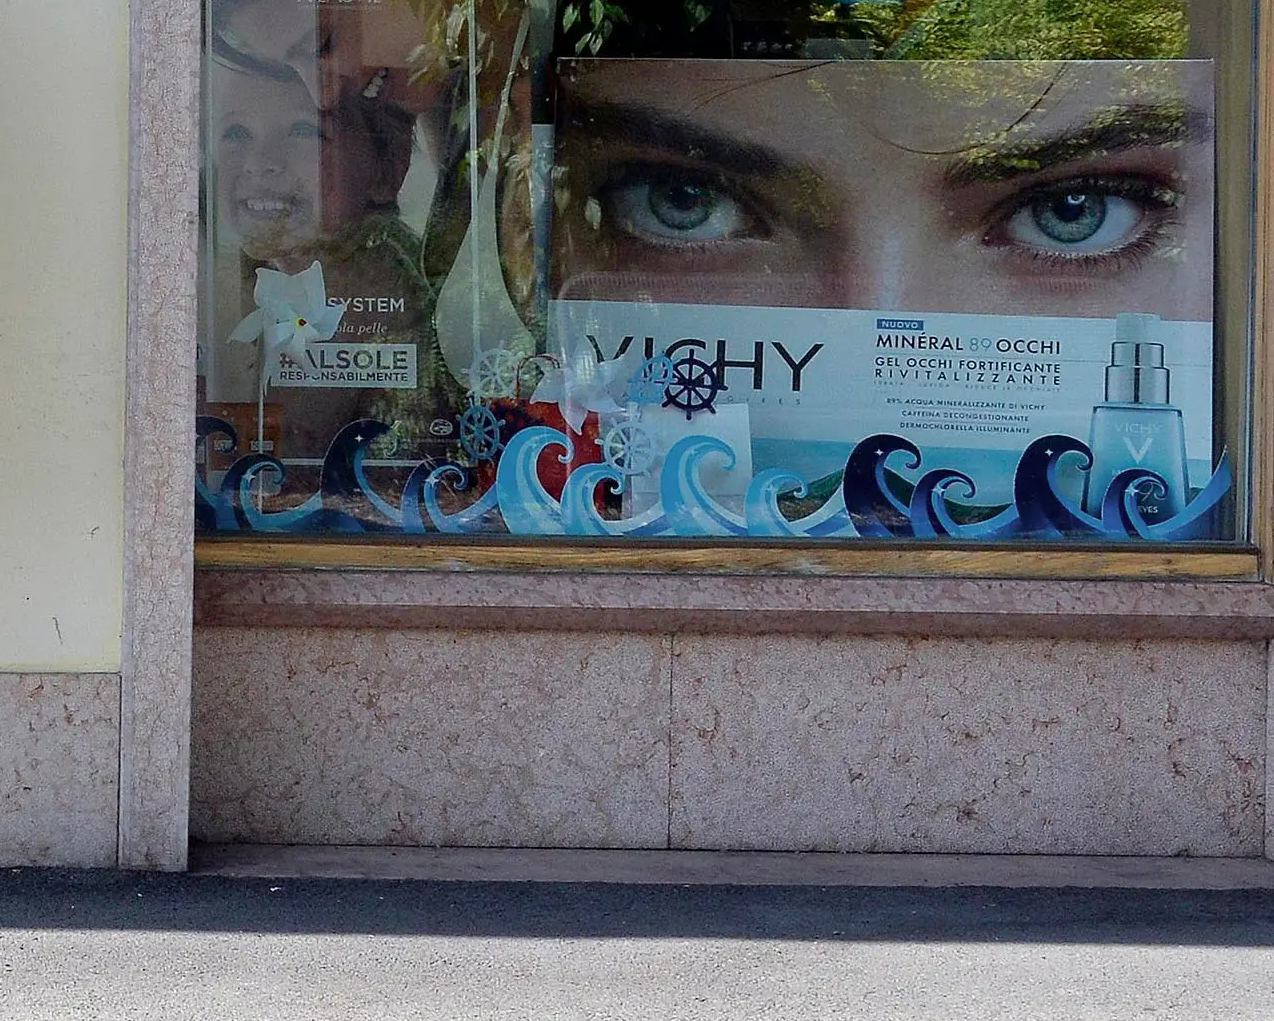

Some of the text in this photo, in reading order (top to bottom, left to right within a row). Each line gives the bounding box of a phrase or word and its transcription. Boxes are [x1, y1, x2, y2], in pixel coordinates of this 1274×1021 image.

[357, 323, 388, 336] pelle
[881, 320, 919, 329] NUOVO
[876, 332, 1061, 355] MINÉRAL 89 OCCHI
[874, 356, 1061, 373] GEL OCCHI FORTIFICANTE
[874, 369, 1061, 386] RIVITALIZZANTE
[904, 398, 934, 406] ACQUA
[937, 399, 1006, 409] MINERALIZZANTE
[901, 410, 1029, 422] CAFFEINA DECONGESTIONANTE
[899, 422, 1031, 434] DERMOCHLORELLA ILLUMINANTE
[1115, 423, 1162, 434] VICHY
